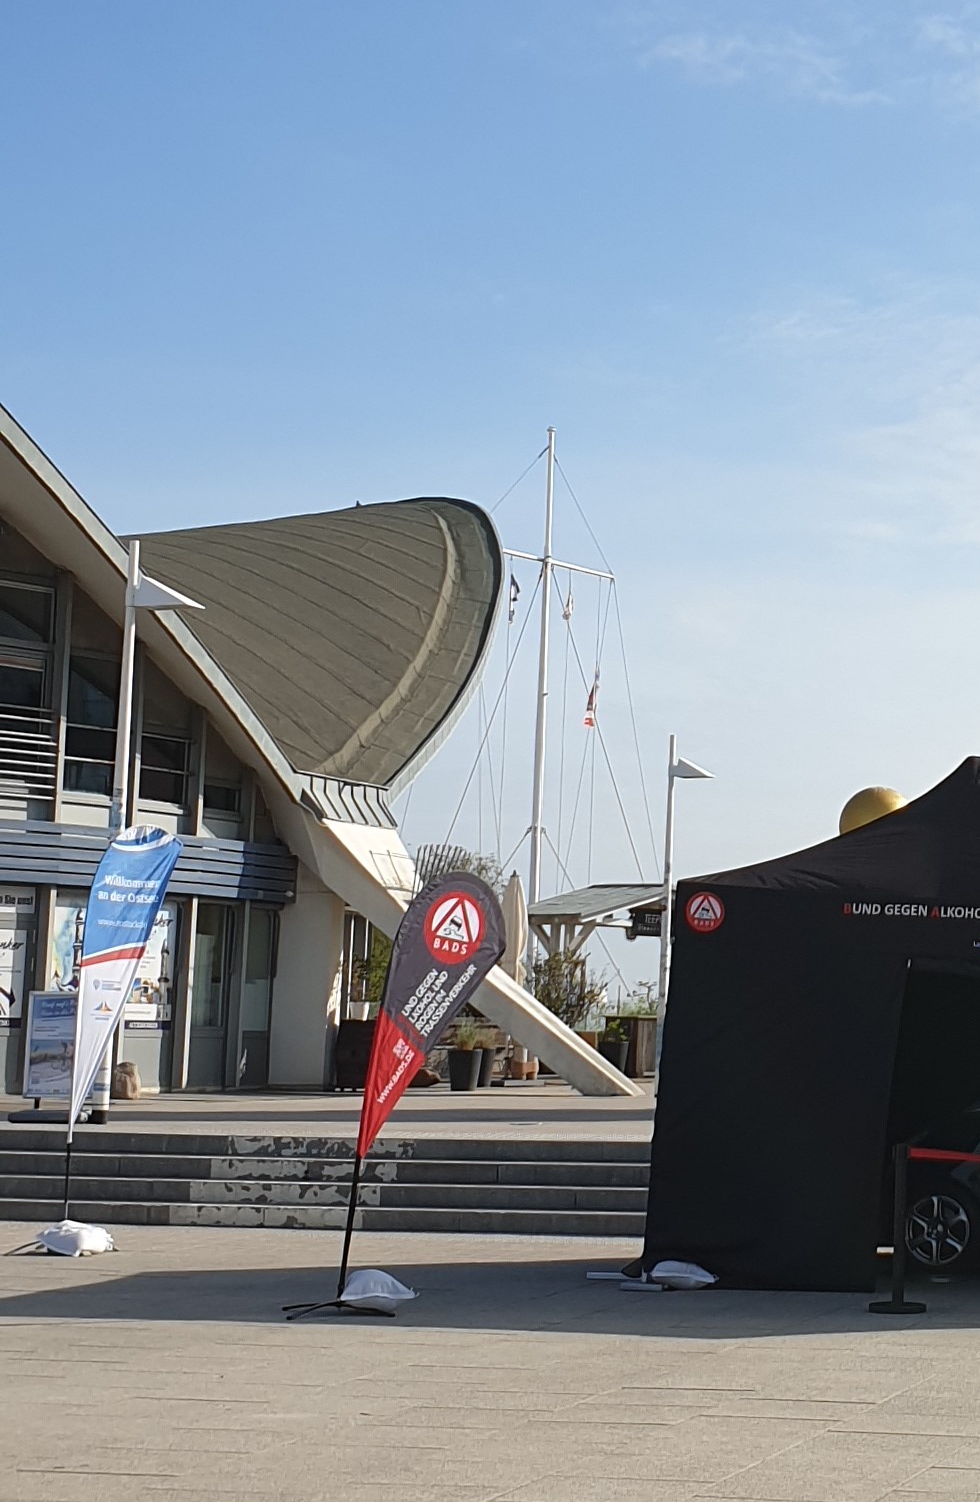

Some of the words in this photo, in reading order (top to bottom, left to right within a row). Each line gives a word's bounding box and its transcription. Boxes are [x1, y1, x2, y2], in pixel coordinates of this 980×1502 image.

[843, 902, 882, 916] BUND
[884, 903, 928, 918] GEGEN
[433, 937, 468, 955] BADS
[415, 968, 439, 999] GEGEN
[433, 970, 448, 993] UND
[434, 988, 447, 1004] IM
